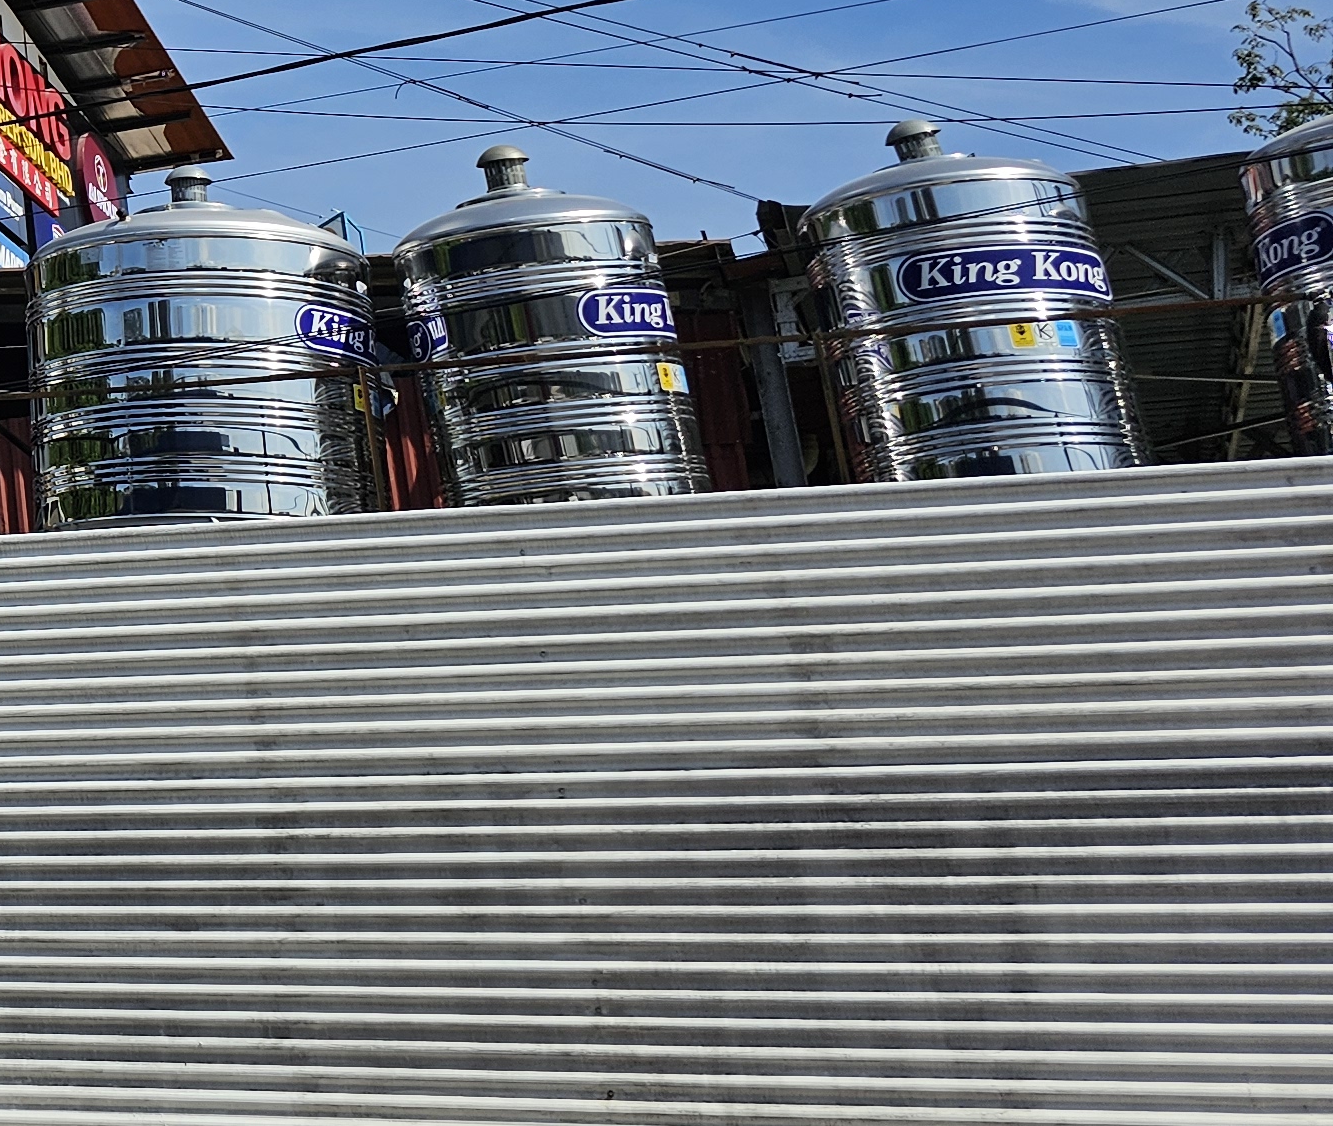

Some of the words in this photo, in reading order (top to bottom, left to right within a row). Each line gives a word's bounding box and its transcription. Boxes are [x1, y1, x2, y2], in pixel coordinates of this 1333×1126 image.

[1257, 224, 1322, 274] Kong
[917, 256, 1022, 291] King
[1031, 251, 1108, 292] Kong
[595, 295, 665, 328] King
